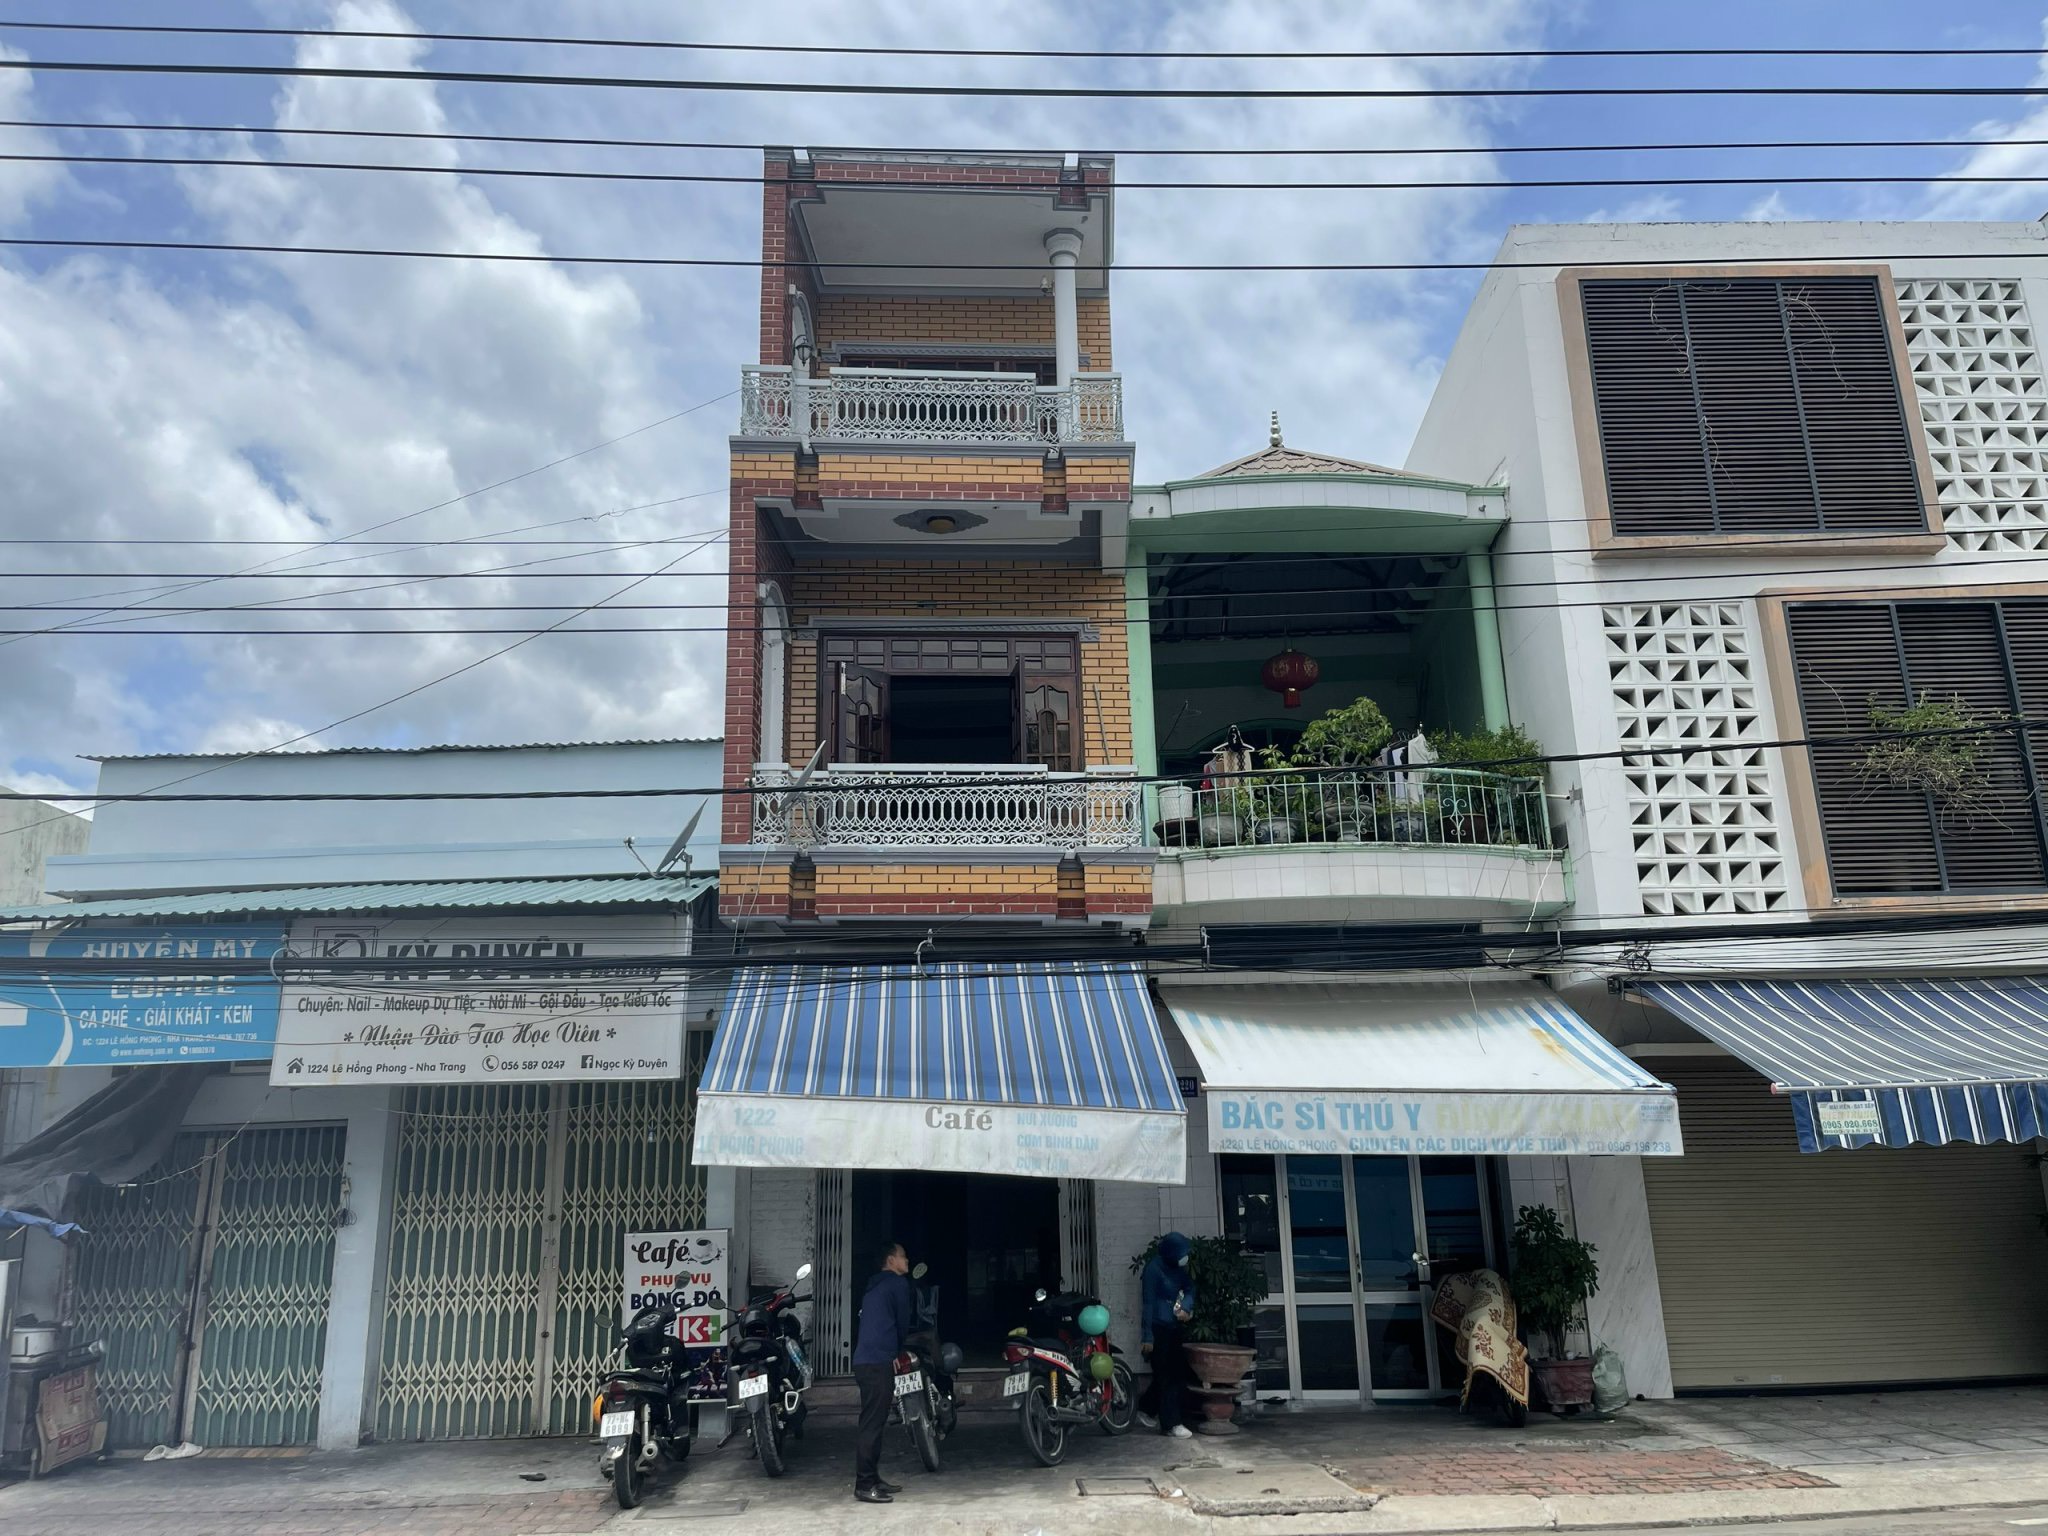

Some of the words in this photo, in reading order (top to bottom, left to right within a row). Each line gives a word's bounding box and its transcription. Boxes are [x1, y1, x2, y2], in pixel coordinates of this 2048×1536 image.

[111, 975, 236, 998] COFFEE
[101, 1004, 129, 1028] PHÊ
[145, 1000, 171, 1026] GIẢI
[176, 1001, 213, 1025] KHÁT
[224, 1005, 253, 1025] KEM
[298, 996, 343, 1016] Chuyên:
[347, 996, 371, 1012] Nail
[383, 996, 429, 1015] Makeup
[433, 995, 449, 1015] Dự
[454, 994, 476, 1015] Tiệc
[512, 993, 526, 1009] Mi
[539, 993, 559, 1014] Gội
[600, 993, 620, 1012] Tạo
[468, 1023, 504, 1048] Tạo
[512, 1023, 550, 1048] Học
[557, 1022, 601, 1043] Viên
[307, 1064, 329, 1073] 1224
[332, 1063, 343, 1073] Lê
[346, 1060, 372, 1075] Hồng
[376, 1064, 407, 1075] Phong
[416, 1063, 436, 1072] Nha
[439, 1063, 466, 1073] Trang
[501, 1061, 519, 1070] 056
[522, 1061, 538, 1070] 587
[541, 1060, 565, 1069] 0247
[595, 1059, 620, 1071] Ngọc
[638, 1058, 667, 1069] Duyên
[734, 1107, 776, 1127] 1222
[925, 1105, 993, 1131] Café
[1221, 1096, 1284, 1130] BÁC
[1295, 1097, 1326, 1130] SĨ
[1335, 1098, 1394, 1131] THÚ
[1403, 1103, 1421, 1131] Y
[1220, 1138, 1244, 1150] 1220
[1298, 1139, 1337, 1151] PHONG
[1349, 1135, 1410, 1152] CHUYÊN
[1416, 1135, 1446, 1151] CÁC
[1451, 1136, 1488, 1152] DỊCH
[1607, 1140, 1631, 1152] 0905
[1634, 1140, 1650, 1152] 196
[1653, 1141, 1671, 1152] 238
[631, 1238, 689, 1269] Café
[690, 1272, 711, 1286] VỤ
[631, 1289, 685, 1310] BÓNG
[682, 1317, 717, 1342] K+
